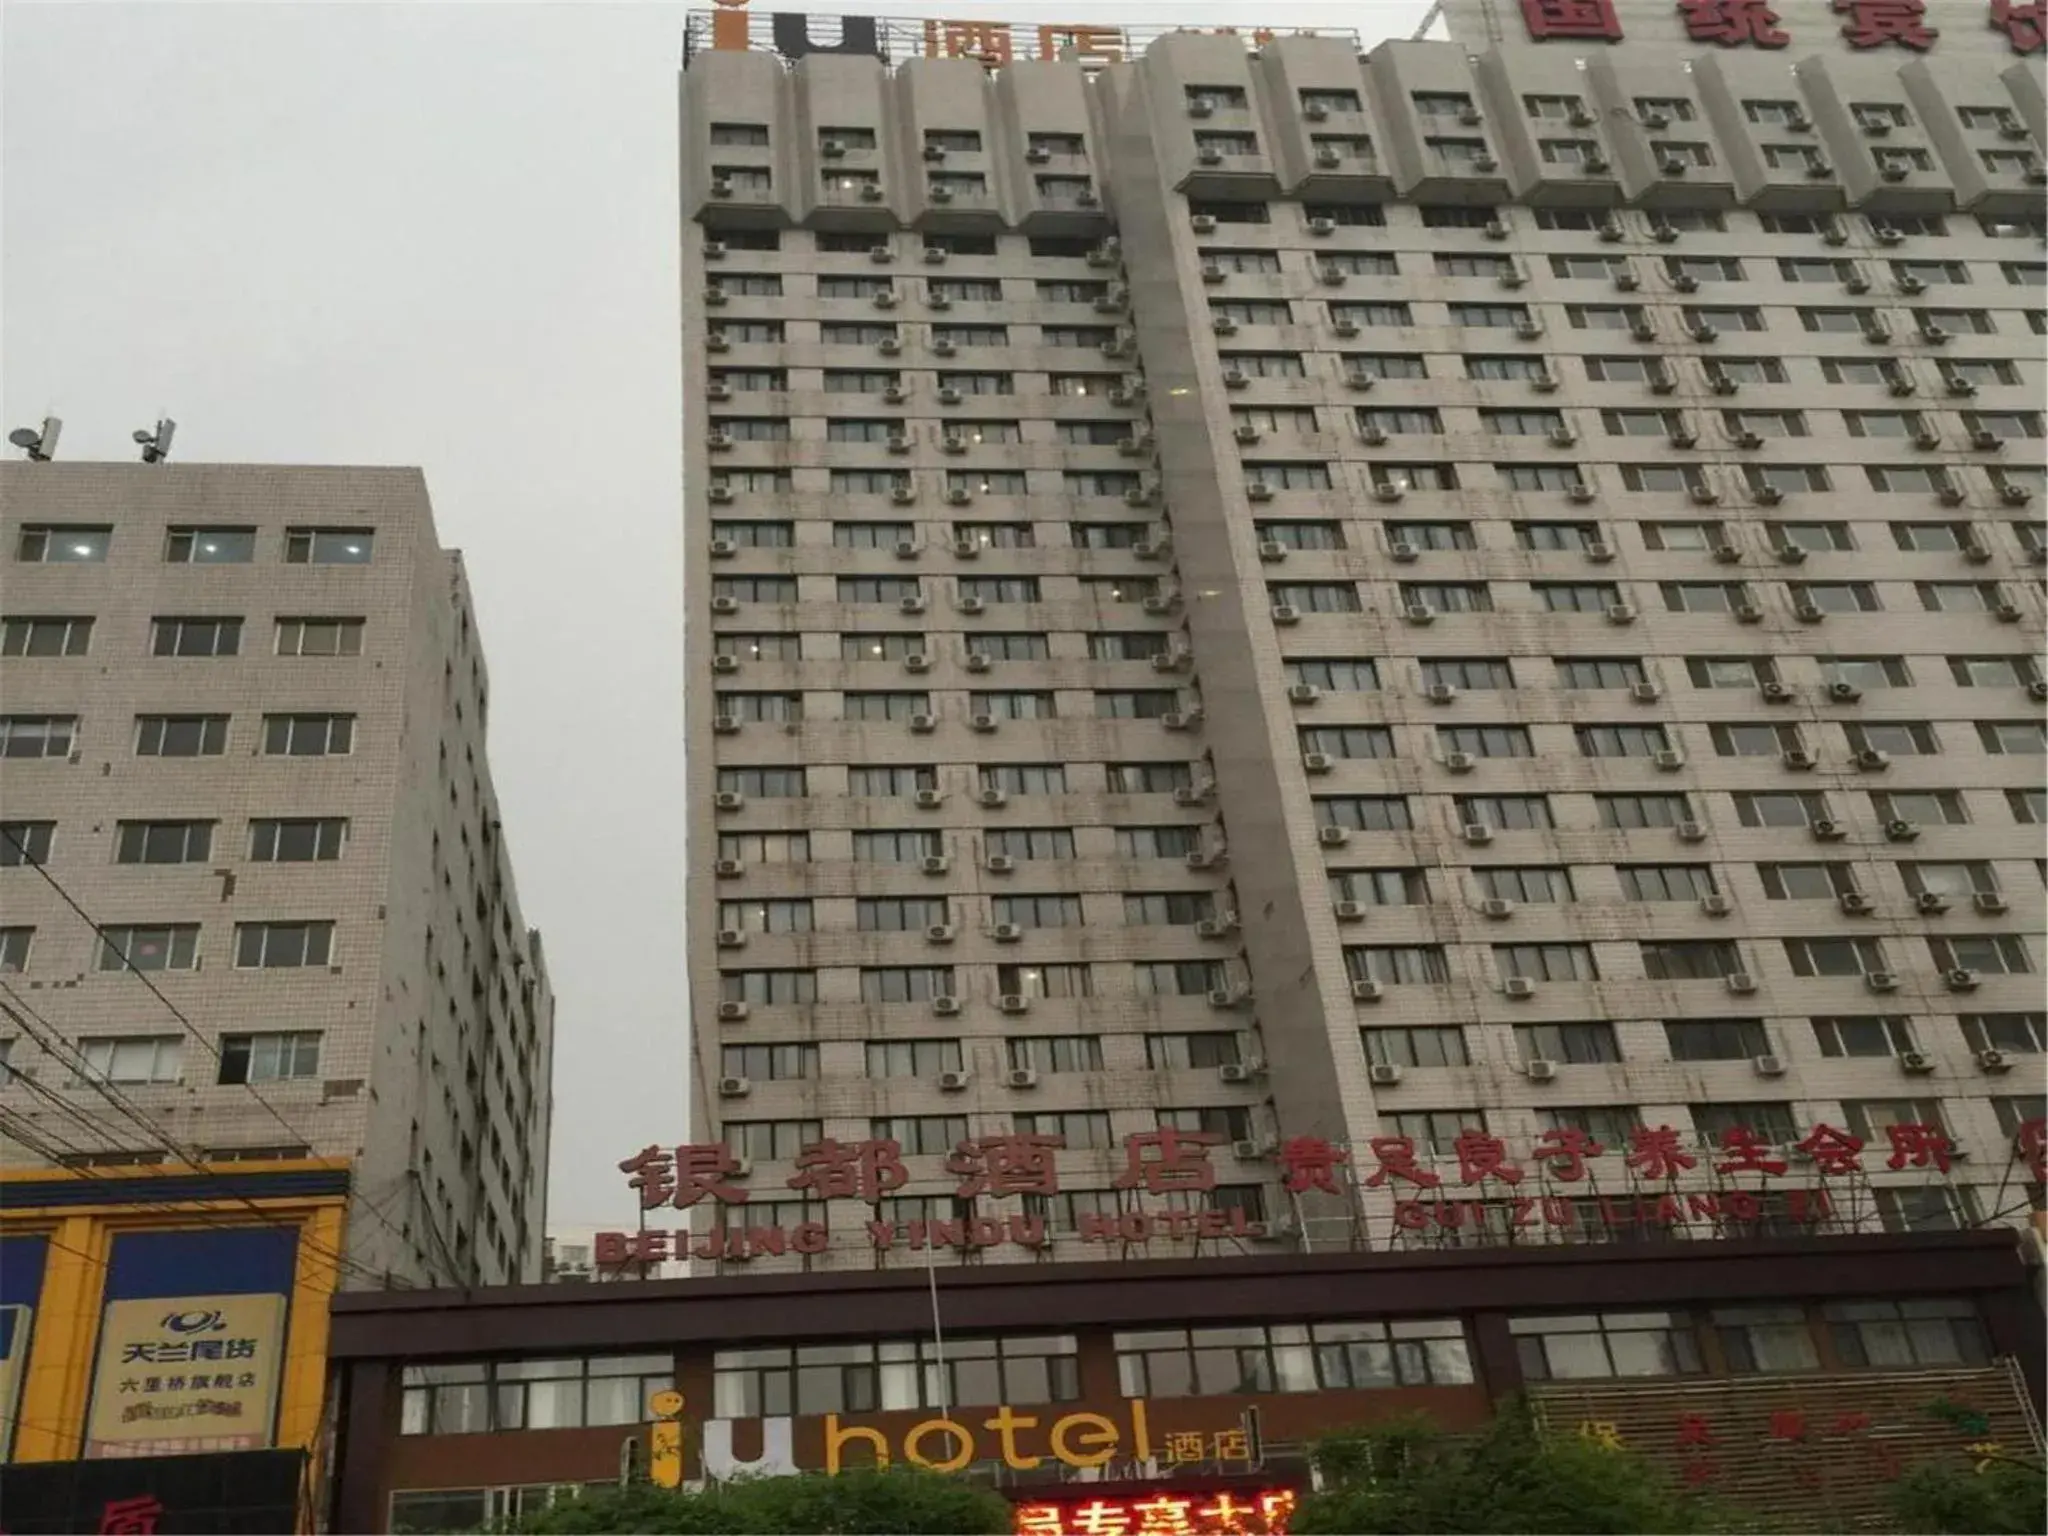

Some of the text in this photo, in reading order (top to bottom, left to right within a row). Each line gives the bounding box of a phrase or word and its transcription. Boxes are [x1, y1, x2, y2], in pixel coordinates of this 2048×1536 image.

[618, 1126, 1224, 1210] 银都酒店
[1274, 1123, 1950, 1194] 贵足良子养生会所
[595, 1204, 1267, 1264] BEIJING YINDU HOTEL
[121, 1338, 257, 1363] 天兰尾货
[119, 1371, 255, 1393] 六里桥旗舰店
[825, 1398, 1149, 1477] hotel
[1163, 1430, 1251, 1462] 酒店
